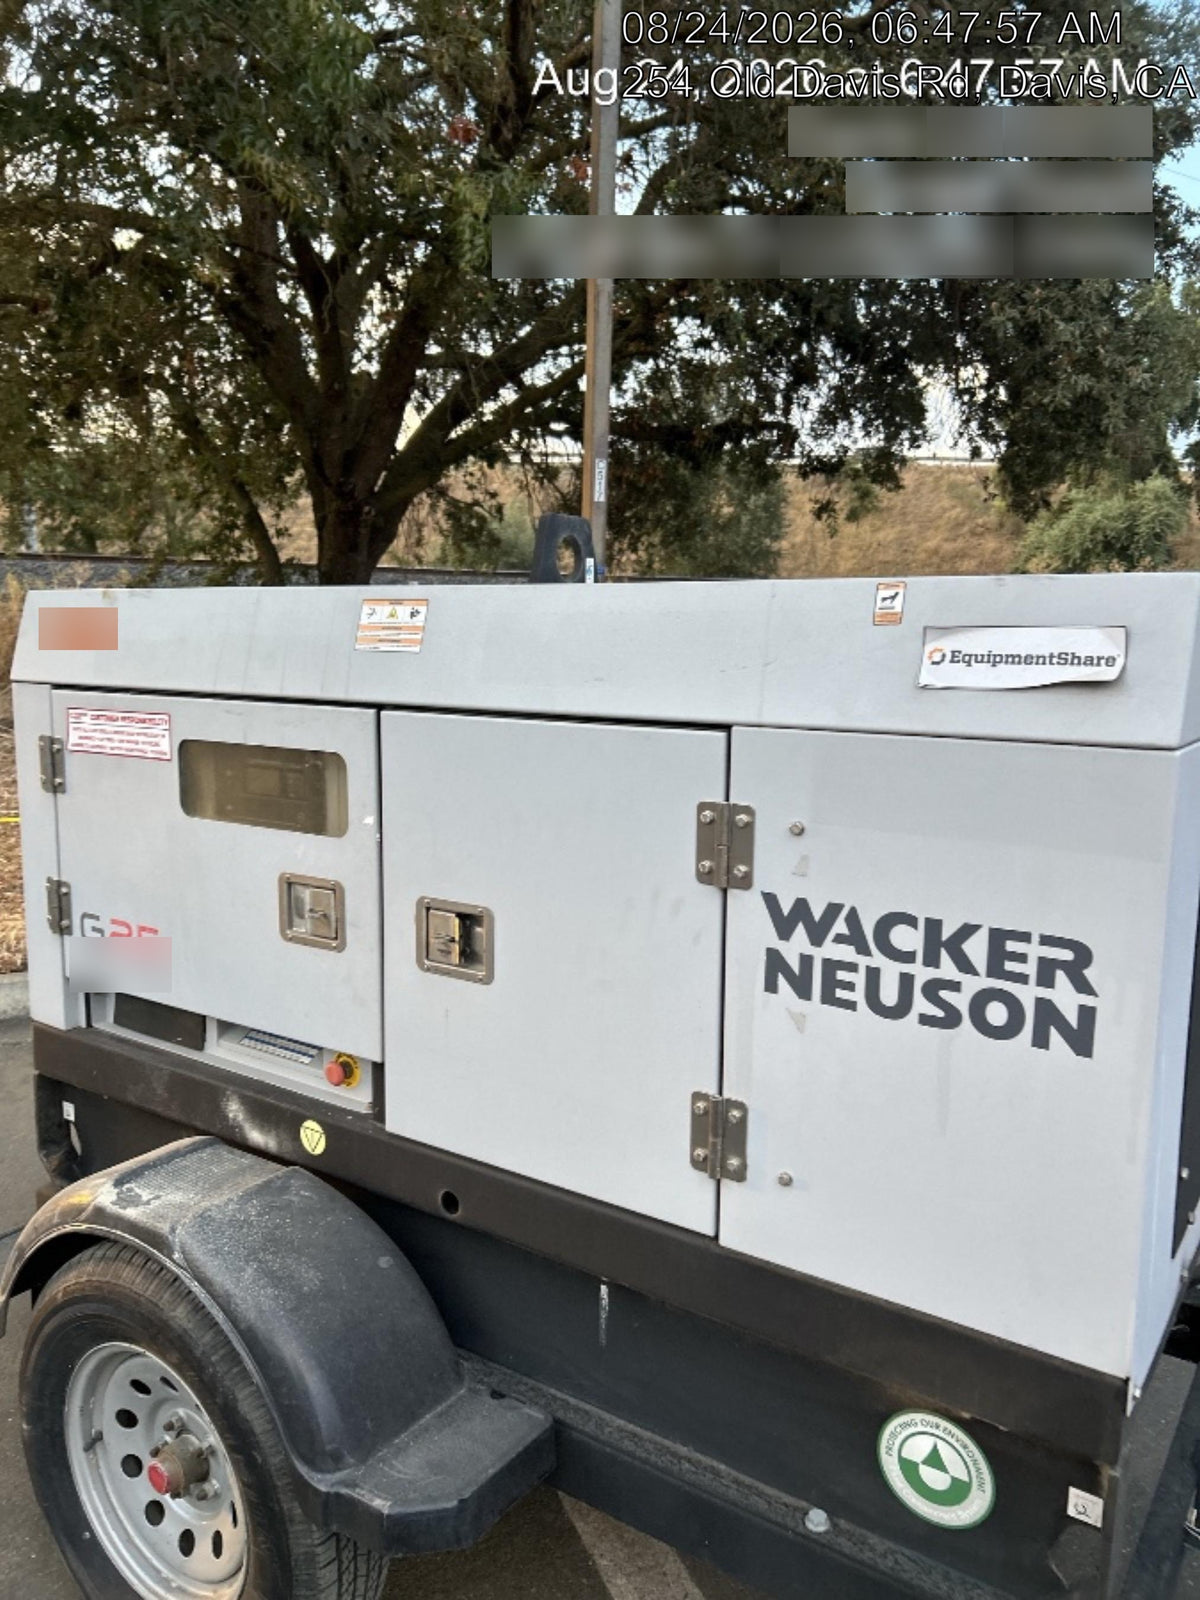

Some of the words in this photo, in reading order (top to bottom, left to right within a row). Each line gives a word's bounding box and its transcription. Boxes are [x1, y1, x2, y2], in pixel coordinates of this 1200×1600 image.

[949, 649, 1117, 668] EquipmentShare
[760, 890, 1099, 998] WACKER
[764, 946, 1097, 1059] NEUSON
